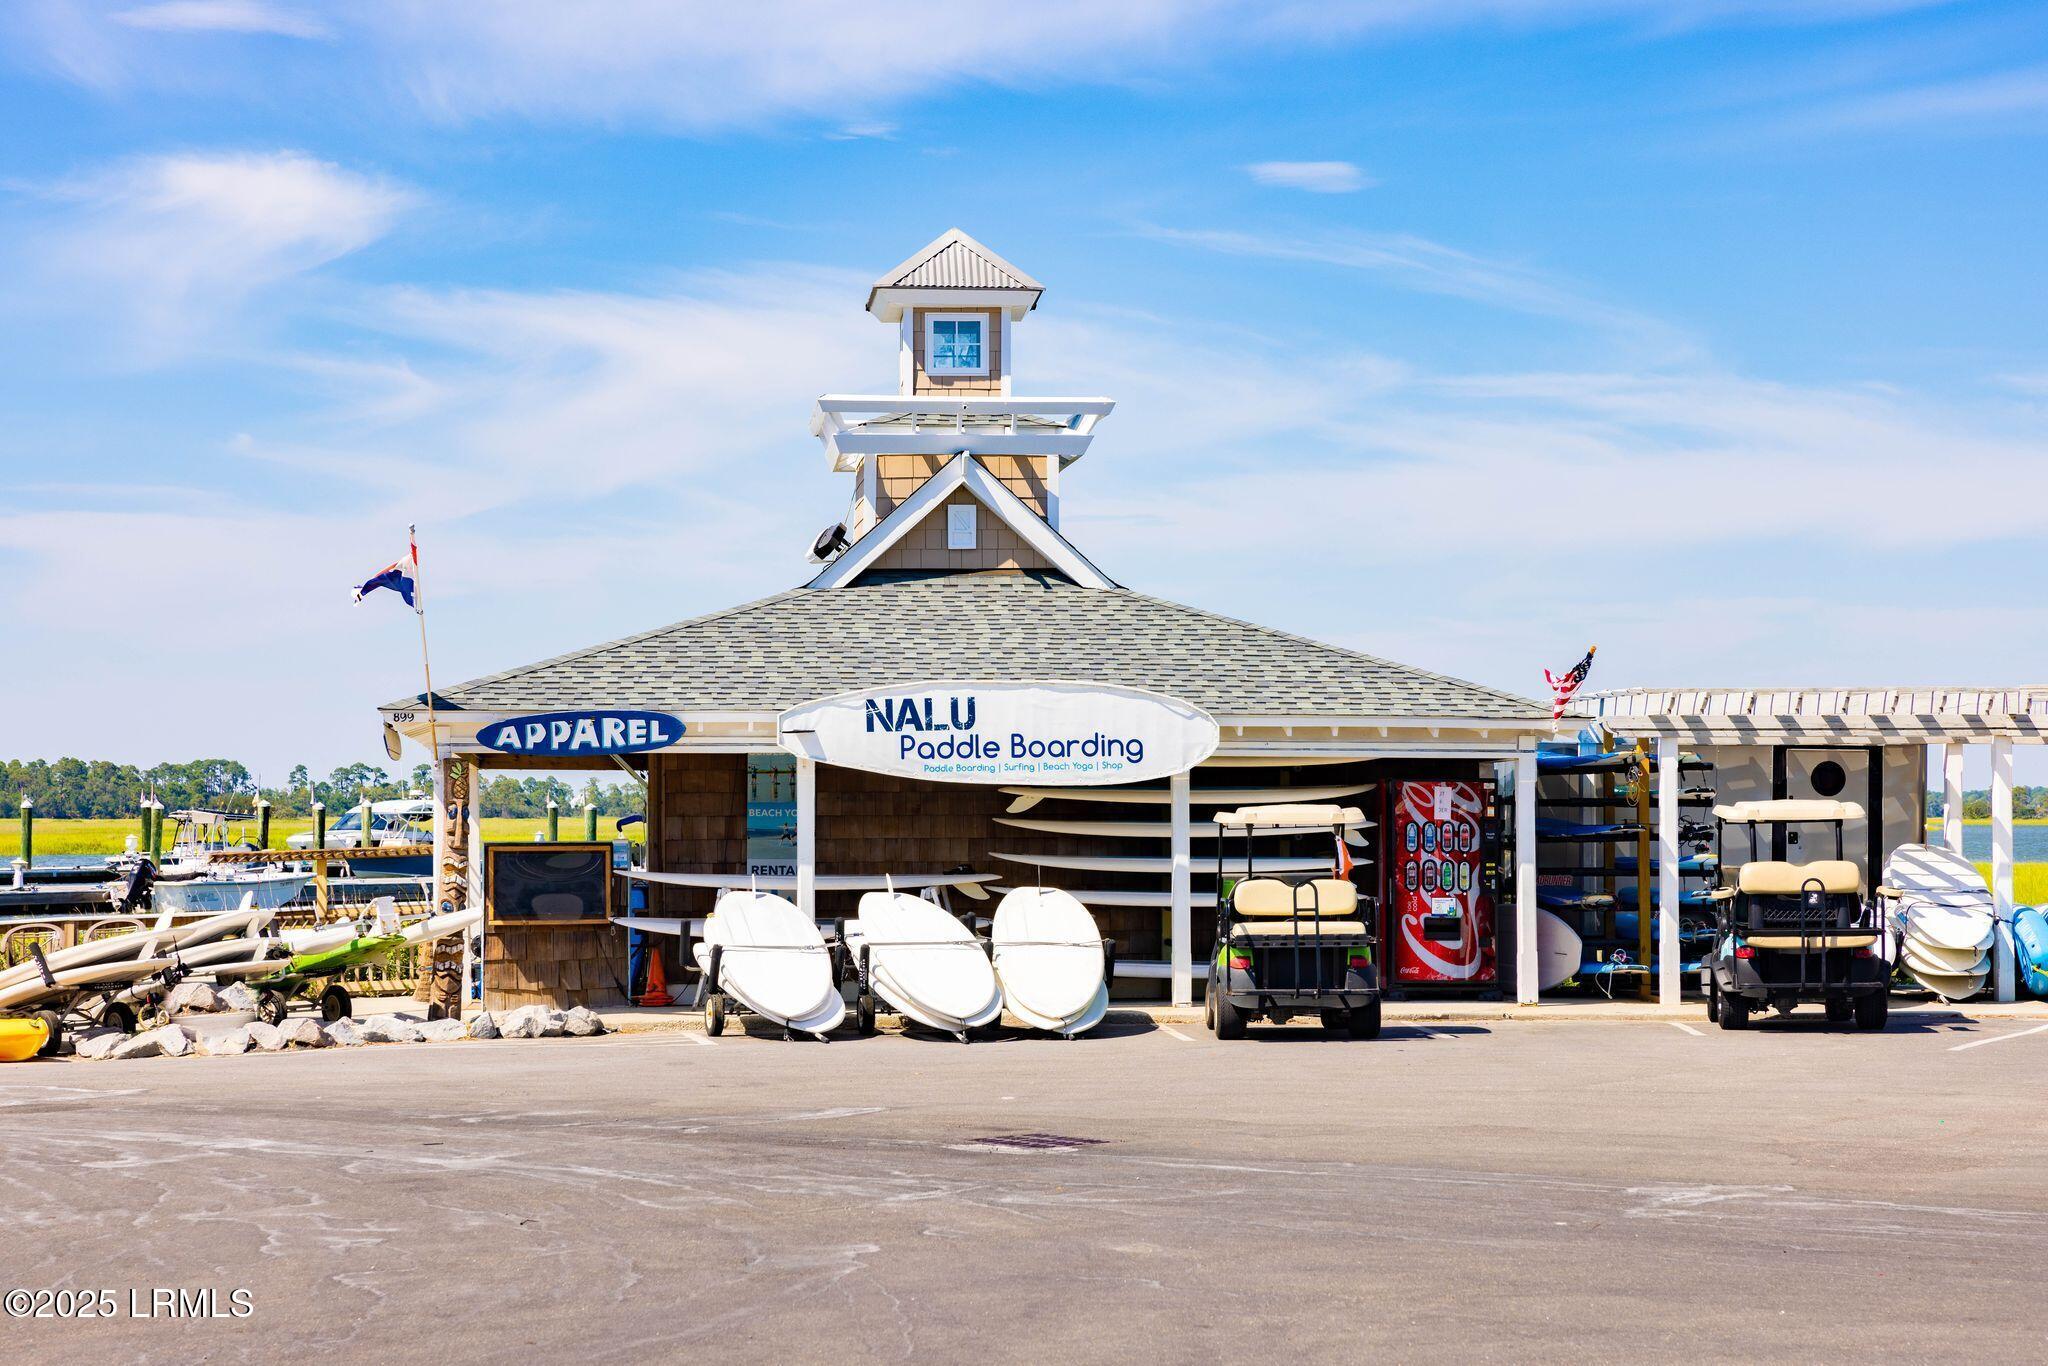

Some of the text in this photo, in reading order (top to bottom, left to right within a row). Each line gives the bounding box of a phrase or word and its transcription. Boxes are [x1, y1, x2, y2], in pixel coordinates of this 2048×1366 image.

[393, 712, 415, 722] 899
[865, 696, 976, 732] NALU
[493, 717, 670, 750] APPAREL
[900, 732, 1144, 764] Paddle Boarding
[923, 761, 1124, 774] Paddle Boarding Surfing Beach Yoga Shop
[748, 808, 782, 817] BEACH
[751, 865, 797, 876] RENTA
